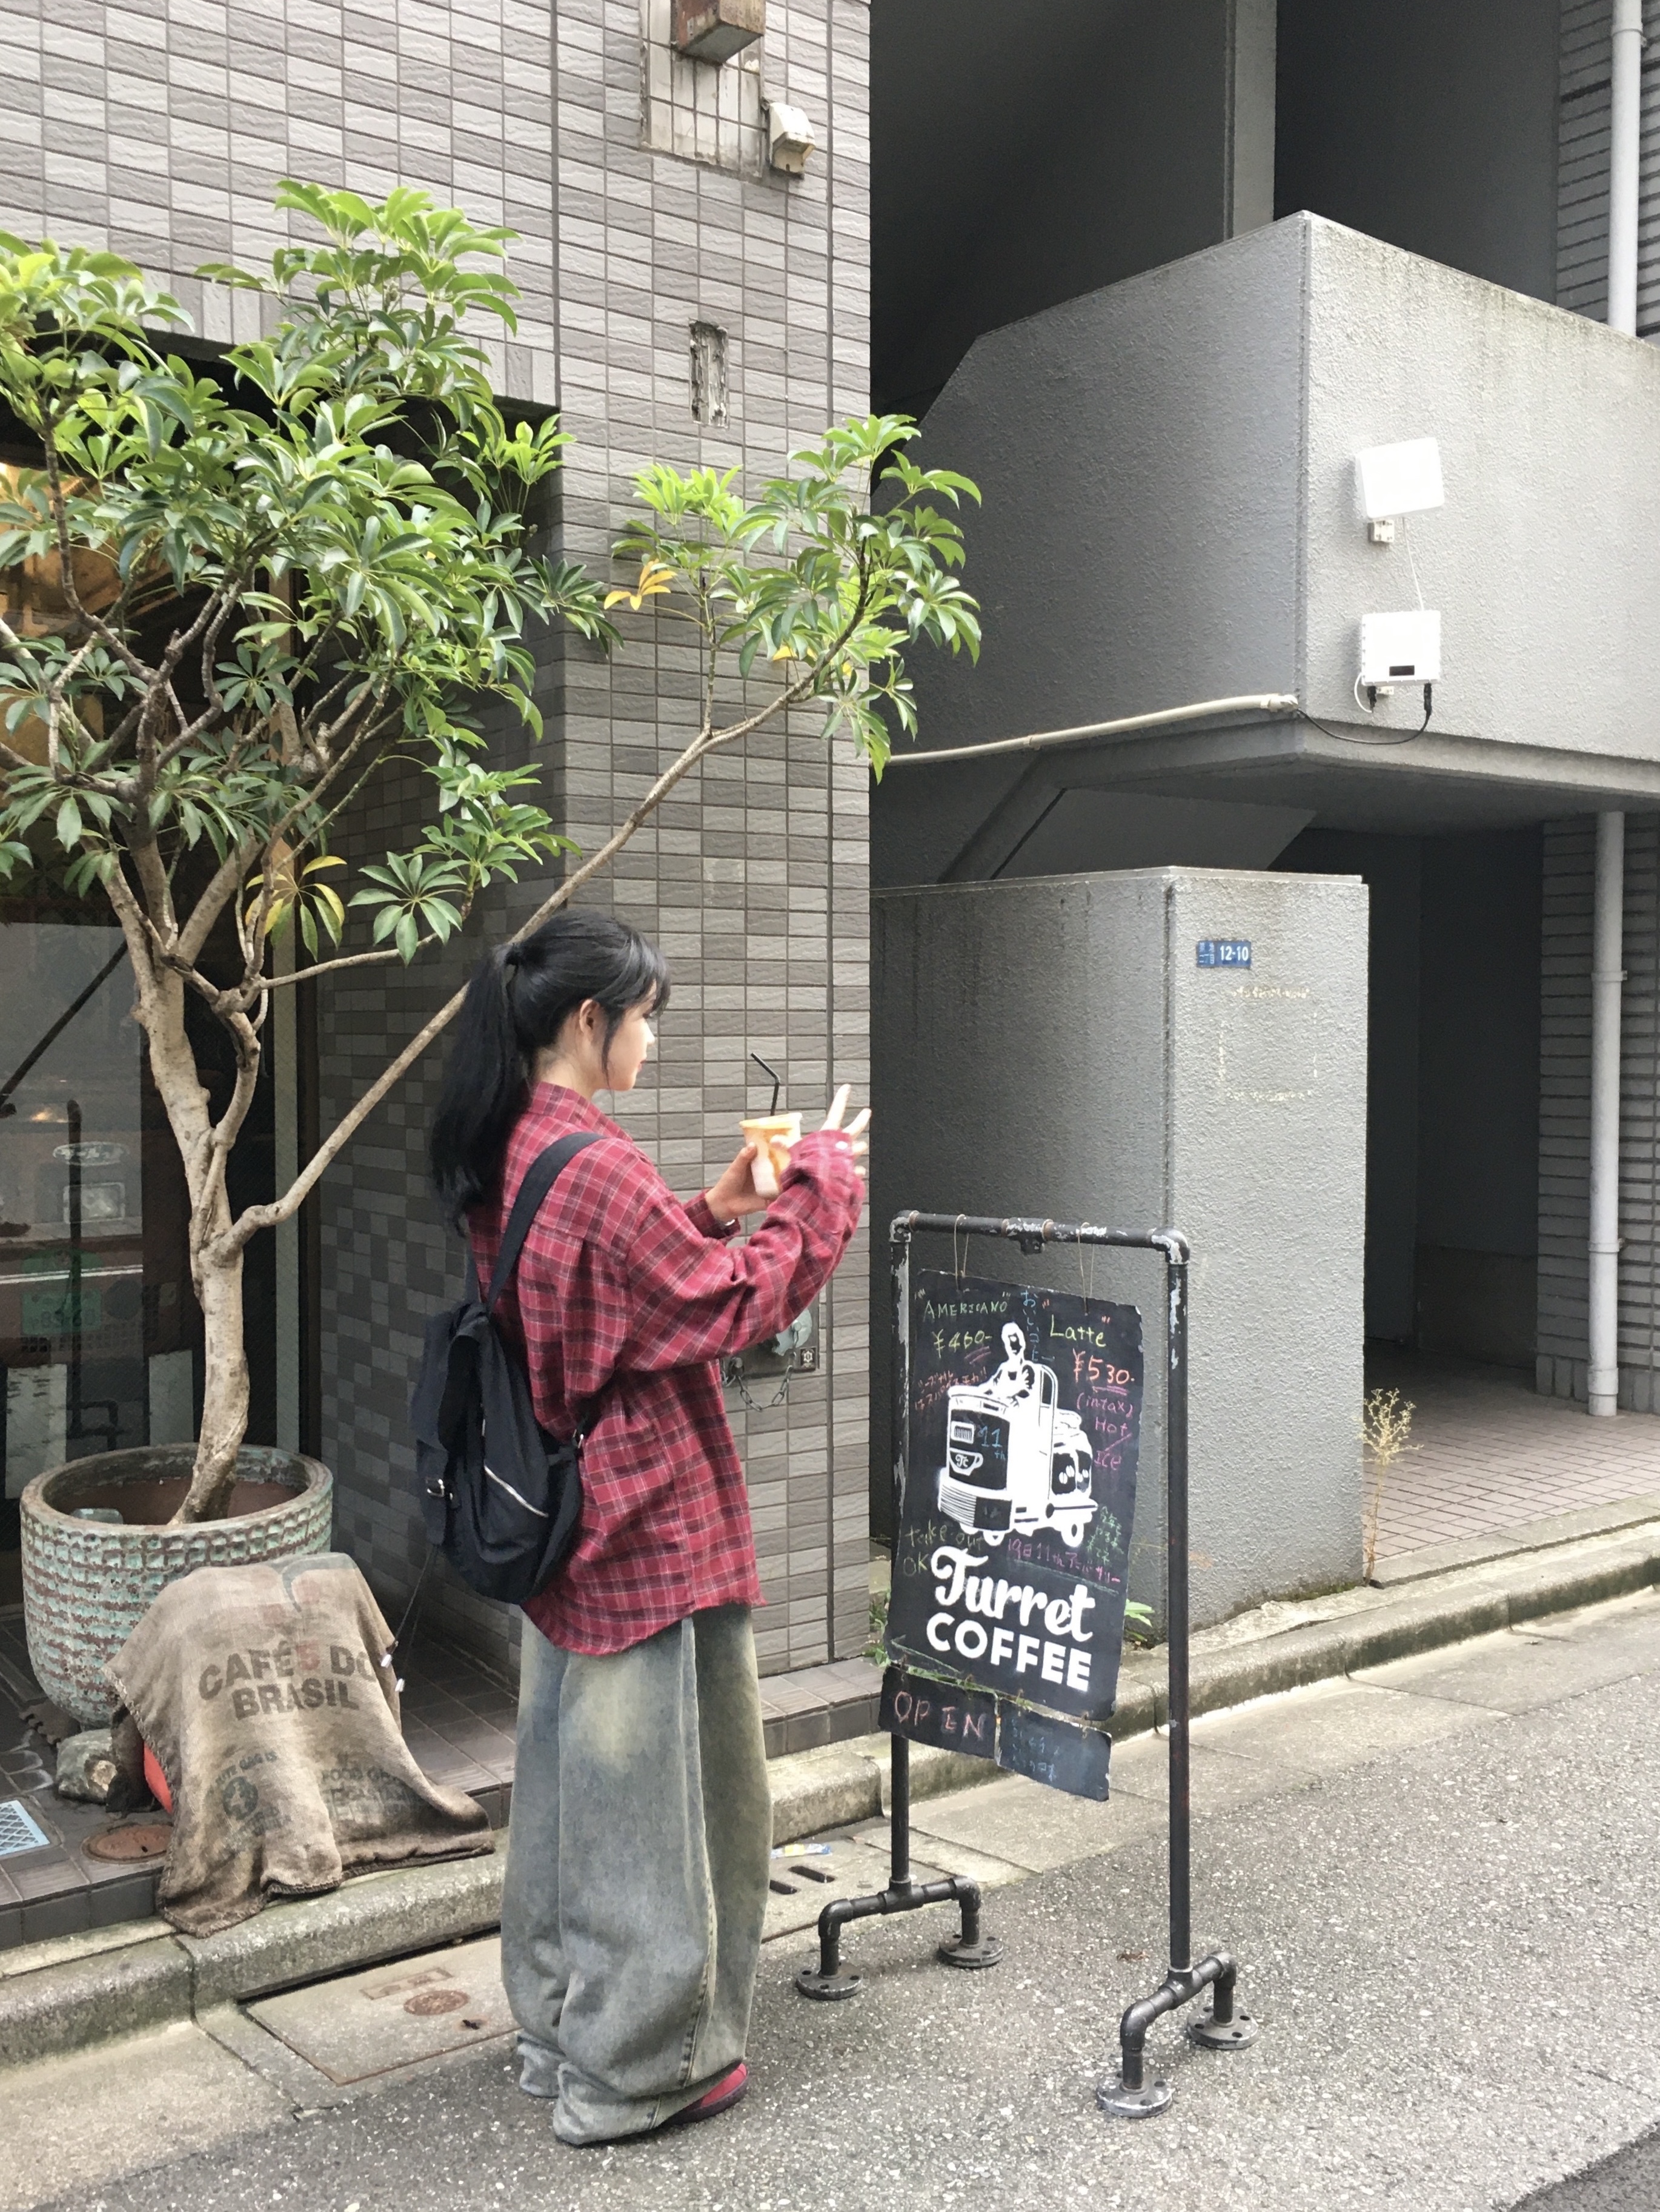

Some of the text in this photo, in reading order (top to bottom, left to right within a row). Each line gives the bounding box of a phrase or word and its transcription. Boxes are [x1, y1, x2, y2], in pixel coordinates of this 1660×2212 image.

[1220, 945, 1249, 962] 12-10
[922, 1299, 1008, 1323] AMERICANO
[1049, 1314, 1107, 1348] Latte
[931, 1545, 1095, 1643] Turret
[926, 1612, 1092, 1692] COFFEE
[231, 1677, 360, 1721] BRASIL
